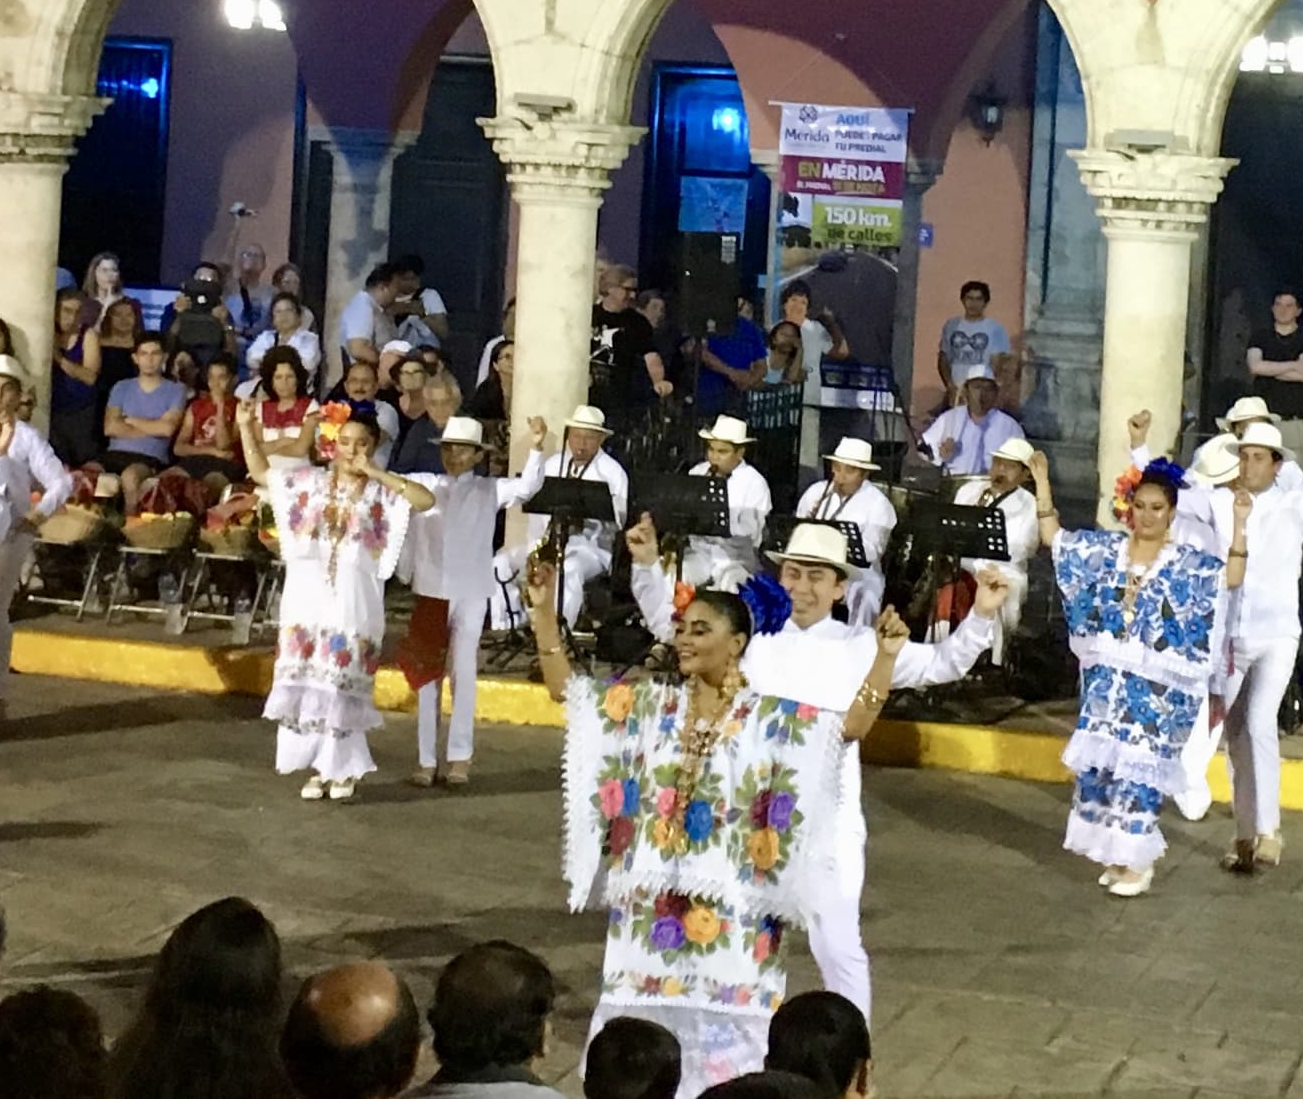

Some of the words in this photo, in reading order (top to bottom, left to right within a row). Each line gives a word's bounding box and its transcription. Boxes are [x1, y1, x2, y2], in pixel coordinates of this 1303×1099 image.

[798, 161, 821, 177] EN
[822, 159, 886, 183] MÉRIDA
[824, 206, 857, 225] 150
[848, 228, 893, 242] calles
